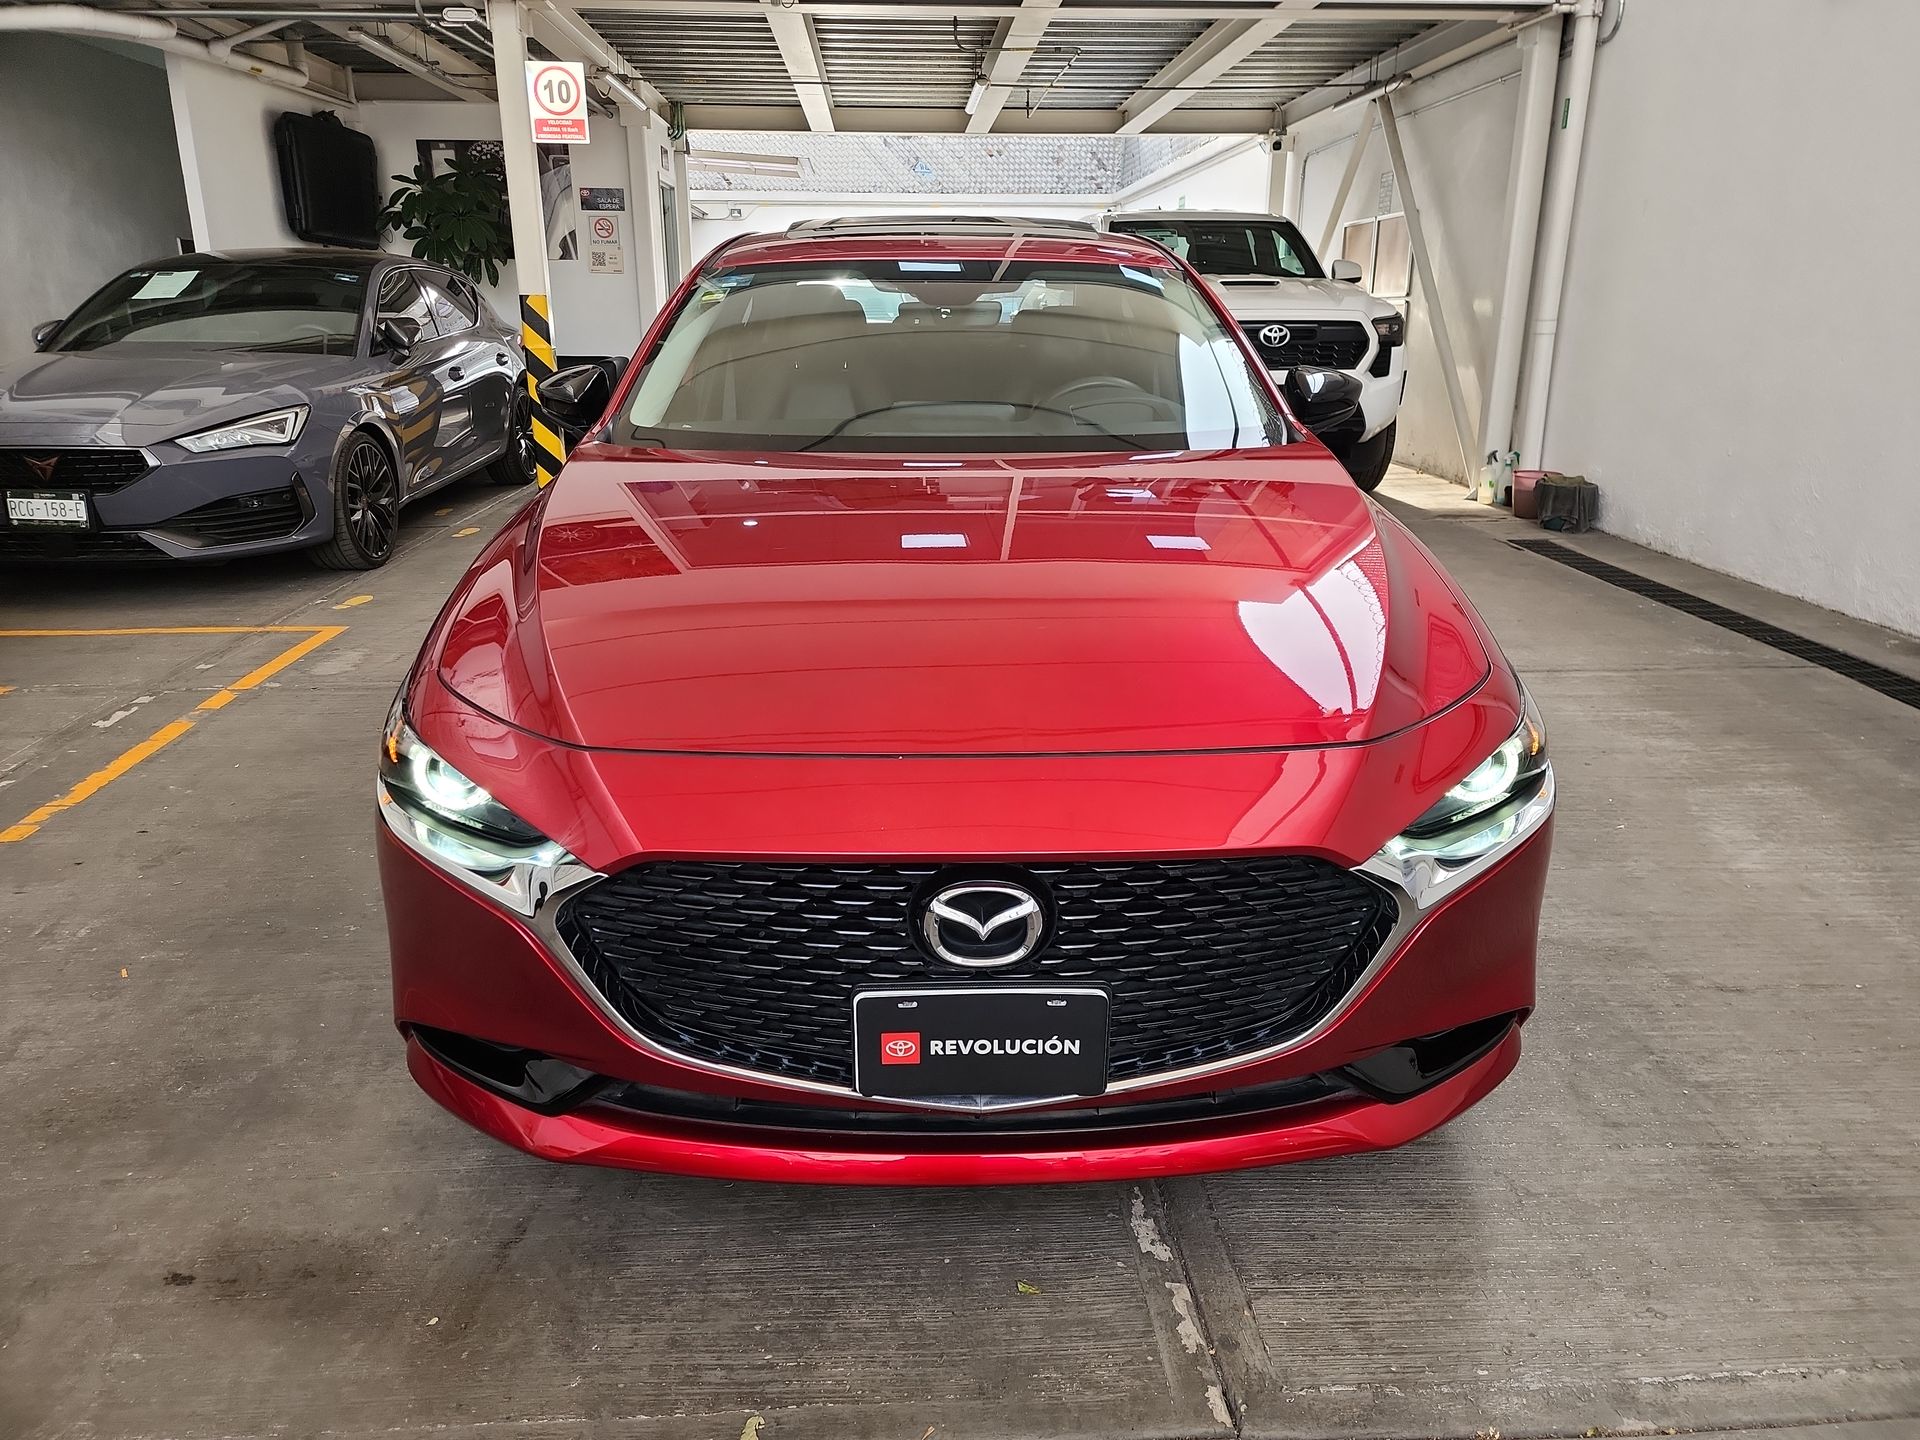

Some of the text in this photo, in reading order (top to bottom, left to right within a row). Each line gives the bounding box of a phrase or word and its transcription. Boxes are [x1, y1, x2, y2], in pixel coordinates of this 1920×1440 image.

[543, 79, 571, 104] 10
[8, 499, 84, 519] RCG-158-E
[930, 1035, 1080, 1055] REVOLUCIÓN
